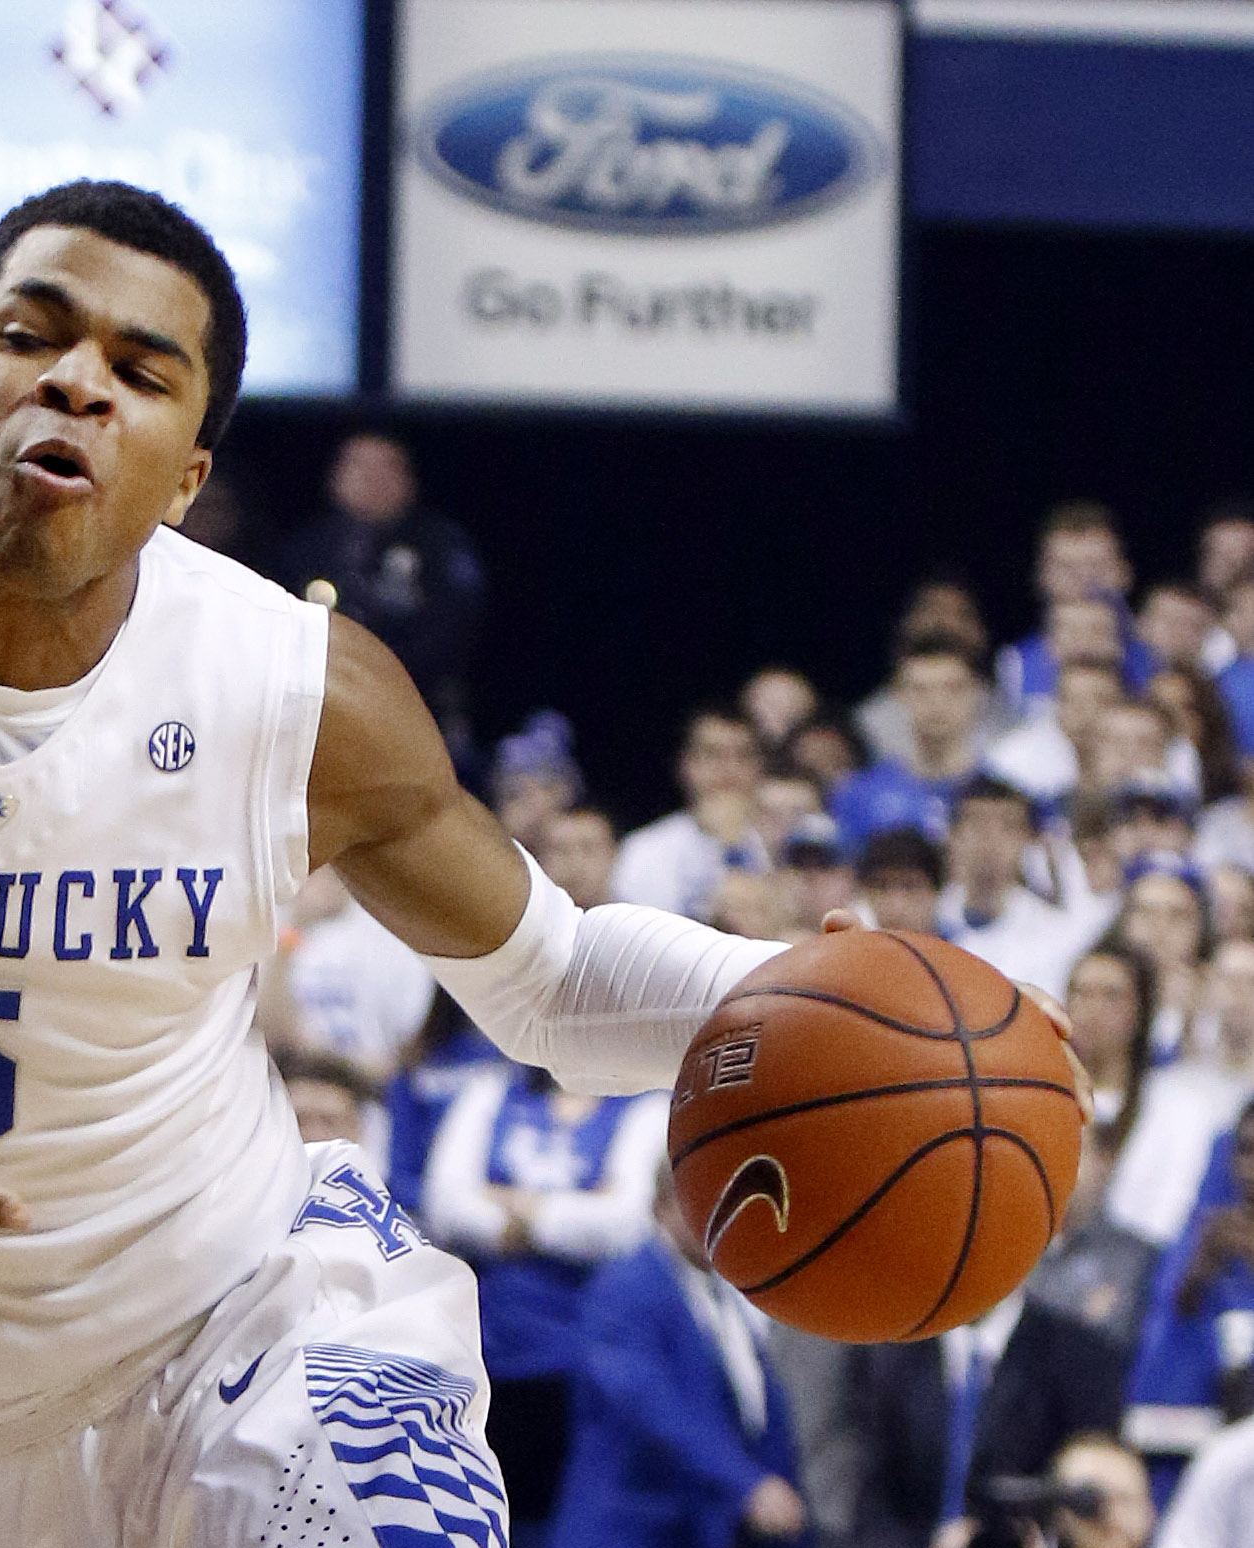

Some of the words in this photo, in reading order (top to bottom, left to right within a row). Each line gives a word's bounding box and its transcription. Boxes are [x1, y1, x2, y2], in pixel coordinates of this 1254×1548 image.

[496, 78, 793, 208] Ford
[460, 264, 560, 332] Go
[574, 268, 816, 340] Further
[149, 722, 195, 771] SEC
